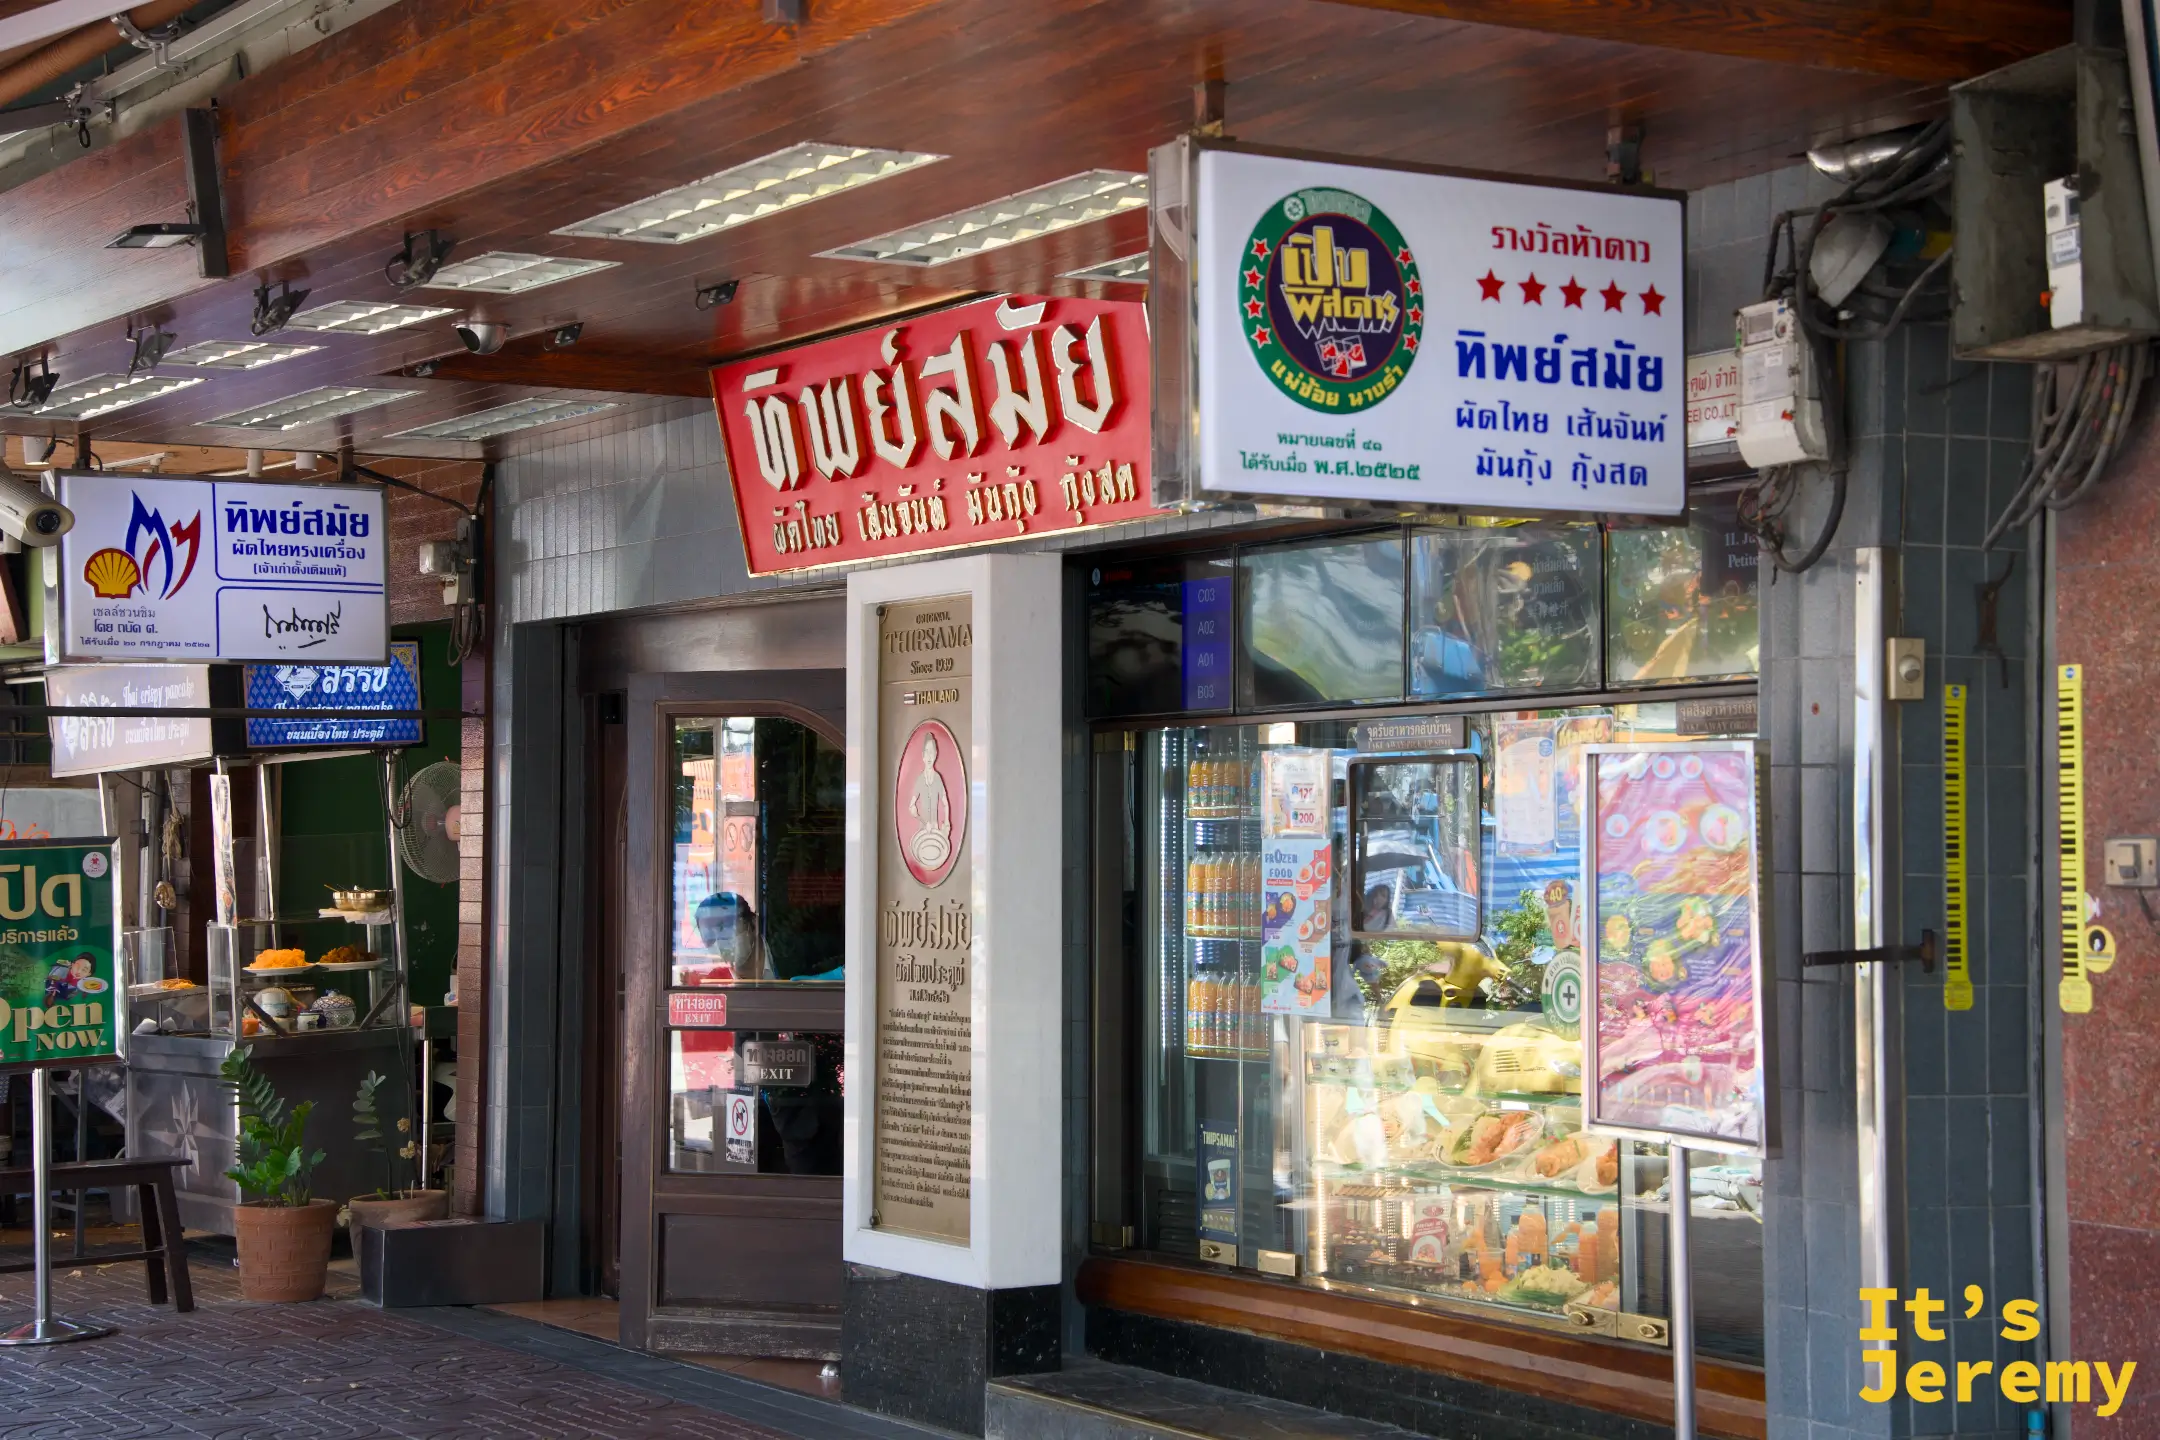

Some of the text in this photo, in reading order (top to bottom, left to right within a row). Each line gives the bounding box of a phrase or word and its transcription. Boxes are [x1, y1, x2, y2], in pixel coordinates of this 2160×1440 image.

[1491, 223, 1650, 264] รางวัลห้าดาว
[1455, 329, 1664, 392] ทิพย์สมัย
[743, 298, 1117, 492] ทิพย์สมัย
[1456, 400, 1668, 442] ผัดไทย เส้นจันท์
[1277, 429, 1356, 450] หมายเลขที่
[1239, 450, 1307, 473] ได้รับเมื่อ
[1476, 447, 1648, 490] มันกุ้ง กุ้งสด
[772, 455, 1137, 554] ผัดไทย เส้นจันท์ มันกุ้ง กุ้งสด
[224, 500, 369, 538] ทิพย์สมัย
[232, 538, 366, 560] ผัดไทยทรงเครื่อง
[1197, 588, 1216, 603] C03
[94, 619, 114, 633] โดย
[1197, 620, 1215, 635] A02
[910, 660, 933, 675] Since
[1197, 653, 1214, 667] A01
[165, 676, 195, 706] pancake
[916, 688, 959, 704] THAILAND
[1197, 685, 1215, 699] B03
[1367, 719, 1452, 742] จุดรับอาหารกลับบ้าน
[1265, 848, 1298, 864] FROZEN
[1269, 868, 1293, 878] FOOD
[883, 897, 973, 951] ทิพย์สมัย
[675, 997, 723, 1010] ทางออก
[685, 1012, 712, 1023] EXIT
[35, 1028, 108, 1052] NOW.
[746, 1048, 806, 1063] ทางออก
[759, 1068, 794, 1080] EXIT
[1203, 1131, 1235, 1149] THIPSAMAI
